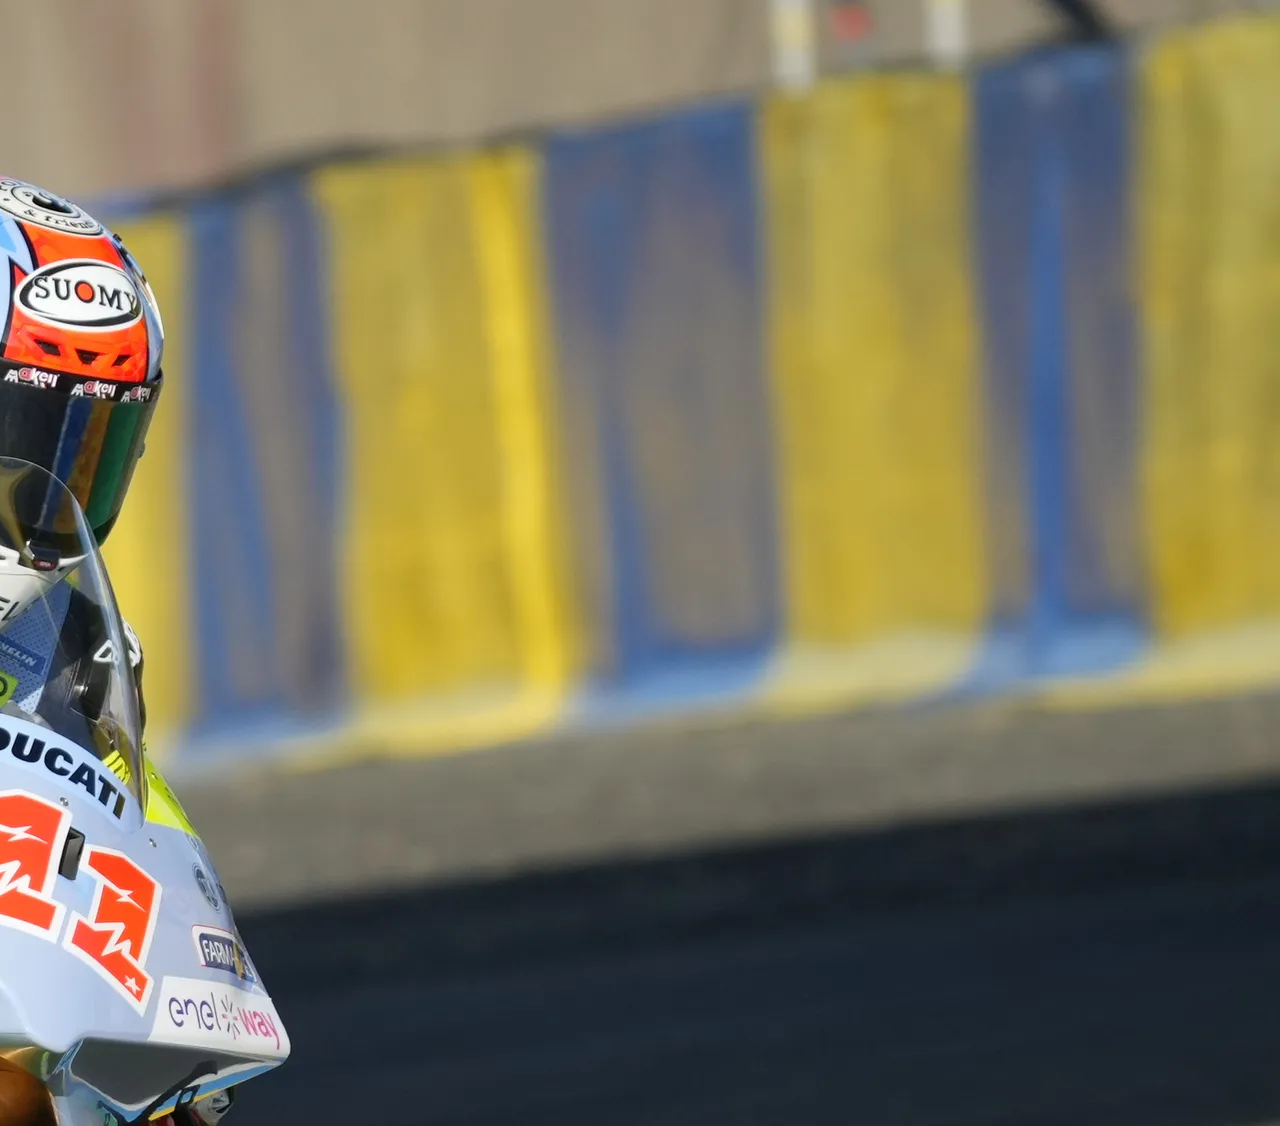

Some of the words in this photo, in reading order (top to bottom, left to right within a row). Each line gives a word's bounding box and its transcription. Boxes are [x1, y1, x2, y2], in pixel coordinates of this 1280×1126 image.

[32, 275, 138, 317] SUOMY
[168, 992, 220, 1031] enel
[237, 1005, 280, 1050] way
